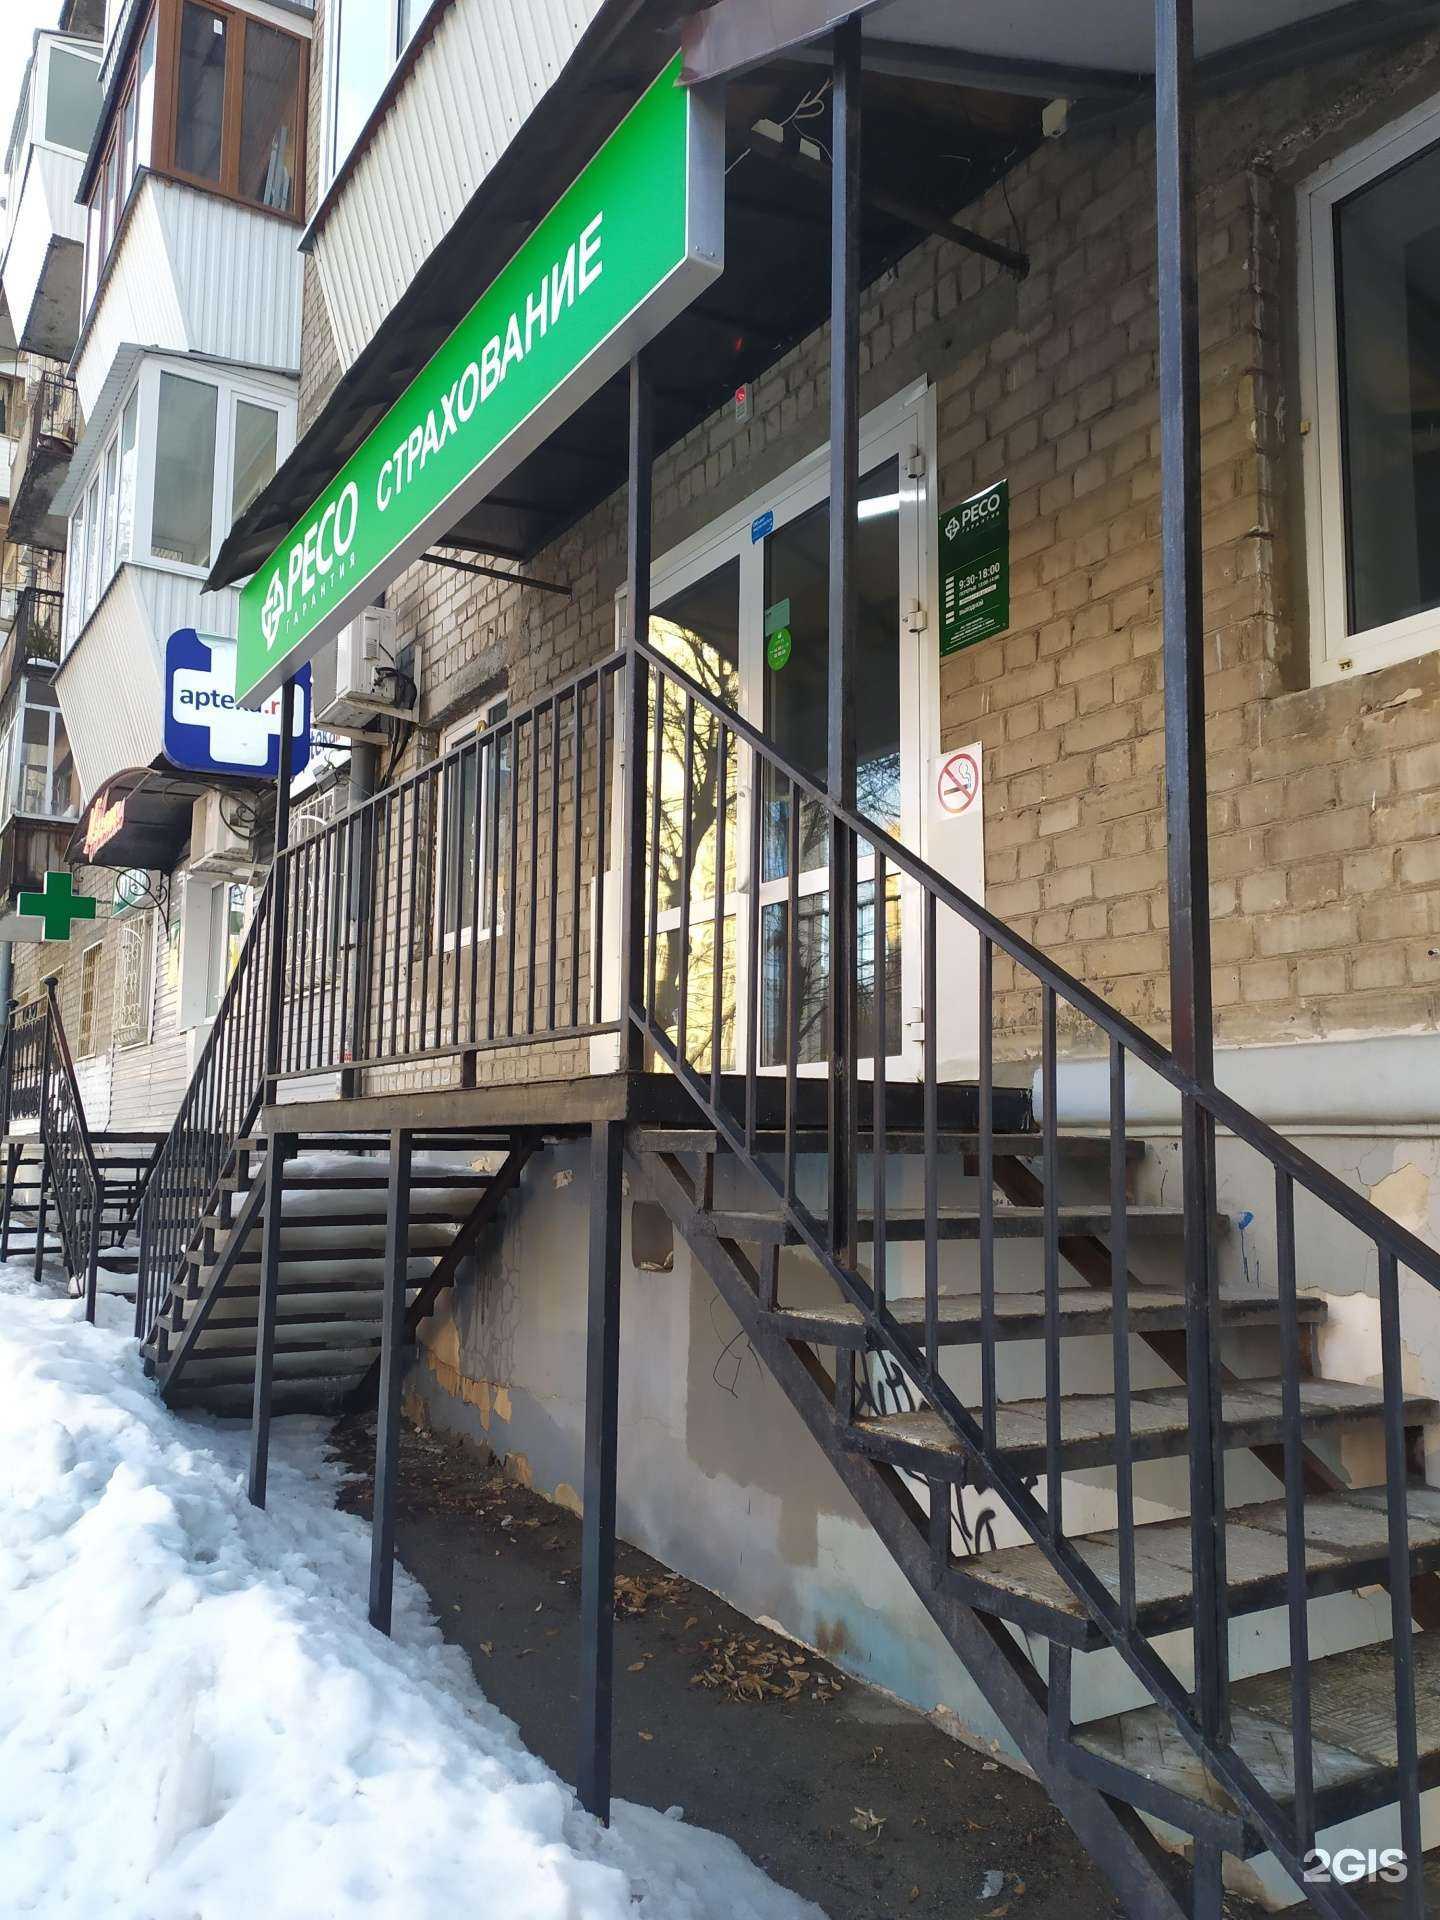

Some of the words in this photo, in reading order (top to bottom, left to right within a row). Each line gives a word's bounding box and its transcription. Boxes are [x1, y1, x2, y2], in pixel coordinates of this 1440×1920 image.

[286, 481, 359, 613] РЕСО
[376, 210, 604, 513] СТРАХОВАНИЕ
[961, 493, 1001, 527] РЕСО
[285, 551, 355, 633] ГАРАНТИЯ
[958, 562, 1001, 590] 9:30-18:00
